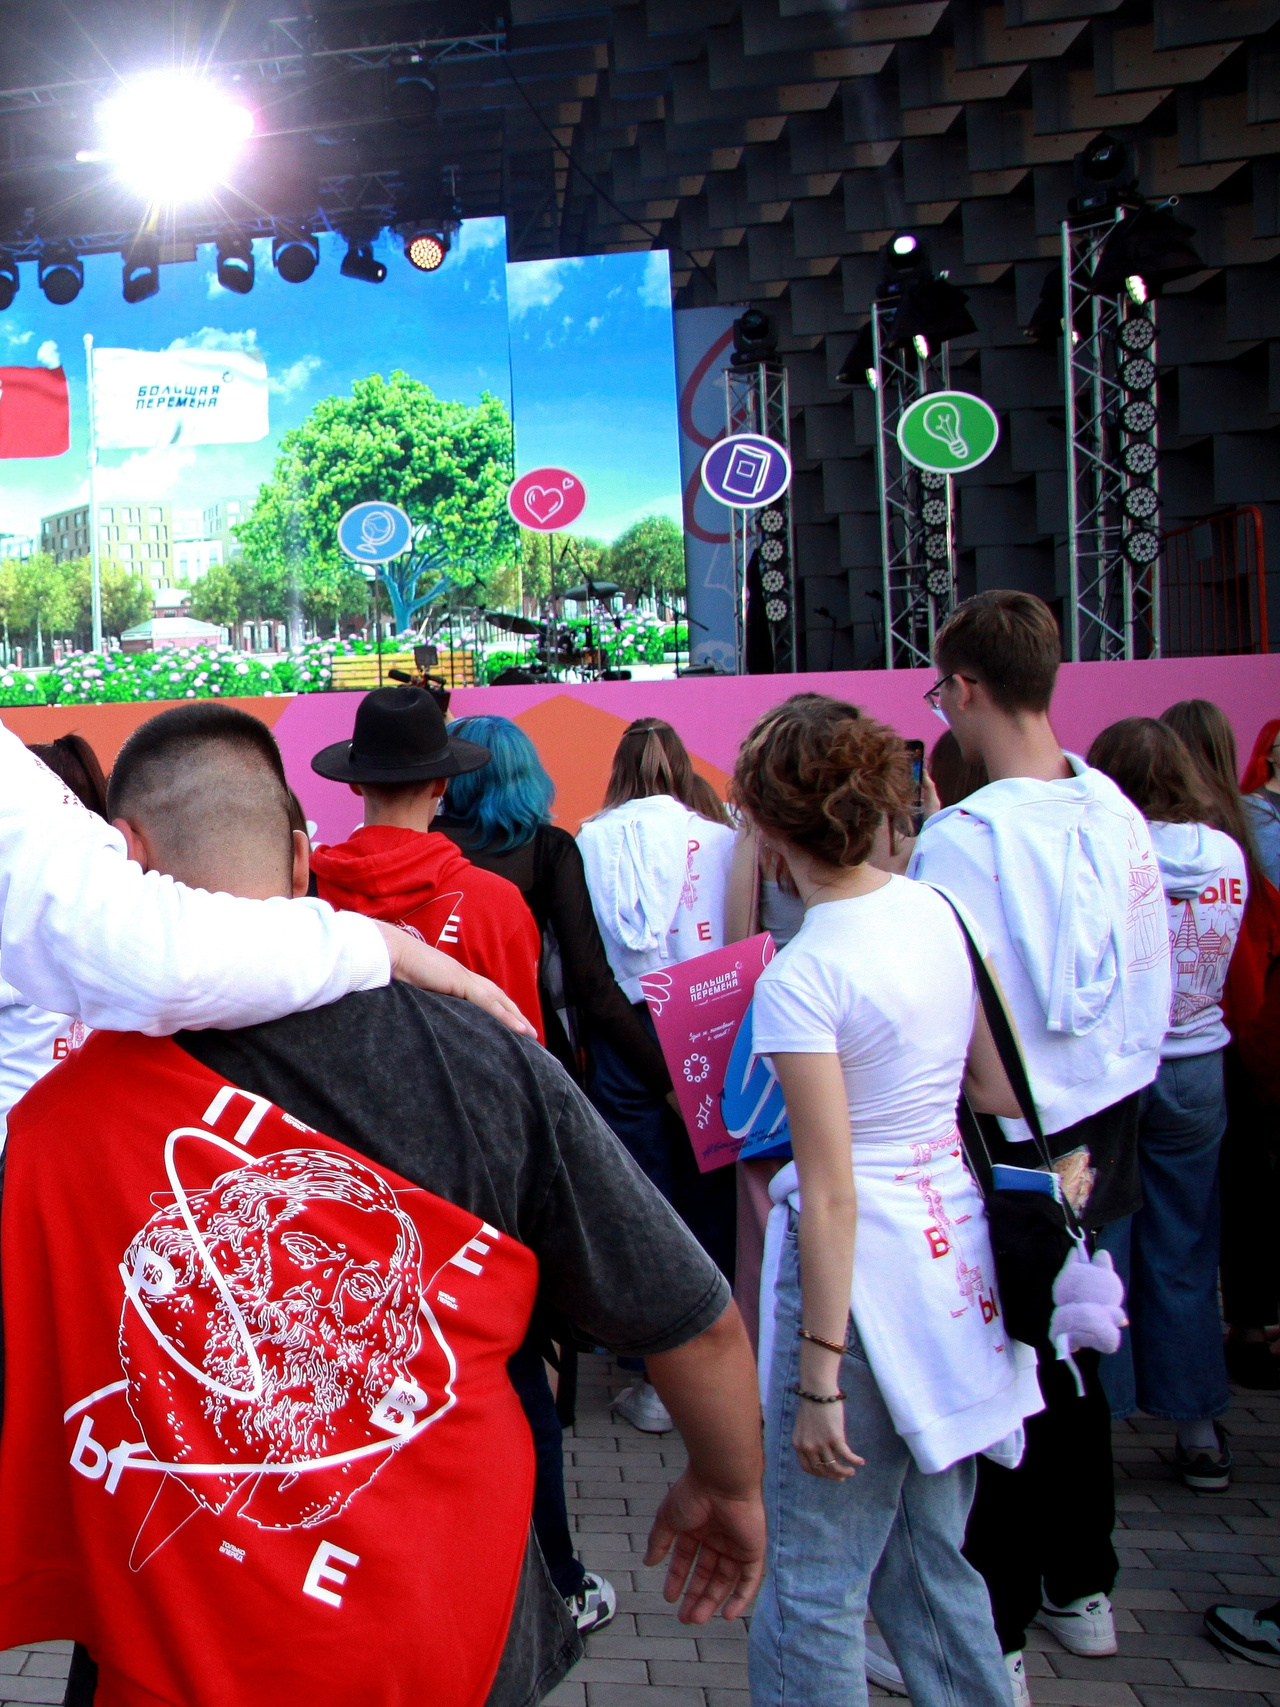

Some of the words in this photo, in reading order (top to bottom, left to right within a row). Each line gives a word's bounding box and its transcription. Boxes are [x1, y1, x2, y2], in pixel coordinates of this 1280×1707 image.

[138, 385, 220, 397] БОЛЬШАЯ
[136, 396, 218, 410] ПЕРЕМЕНА
[696, 921, 713, 941] Е
[689, 970, 738, 994] БОЛЬШАЯ
[690, 978, 739, 1002] ПЕРЕМЕНА
[922, 1225, 951, 1259] В
[222, 1540, 247, 1556] ТОЛЬКО
[302, 1539, 360, 1608] Е
